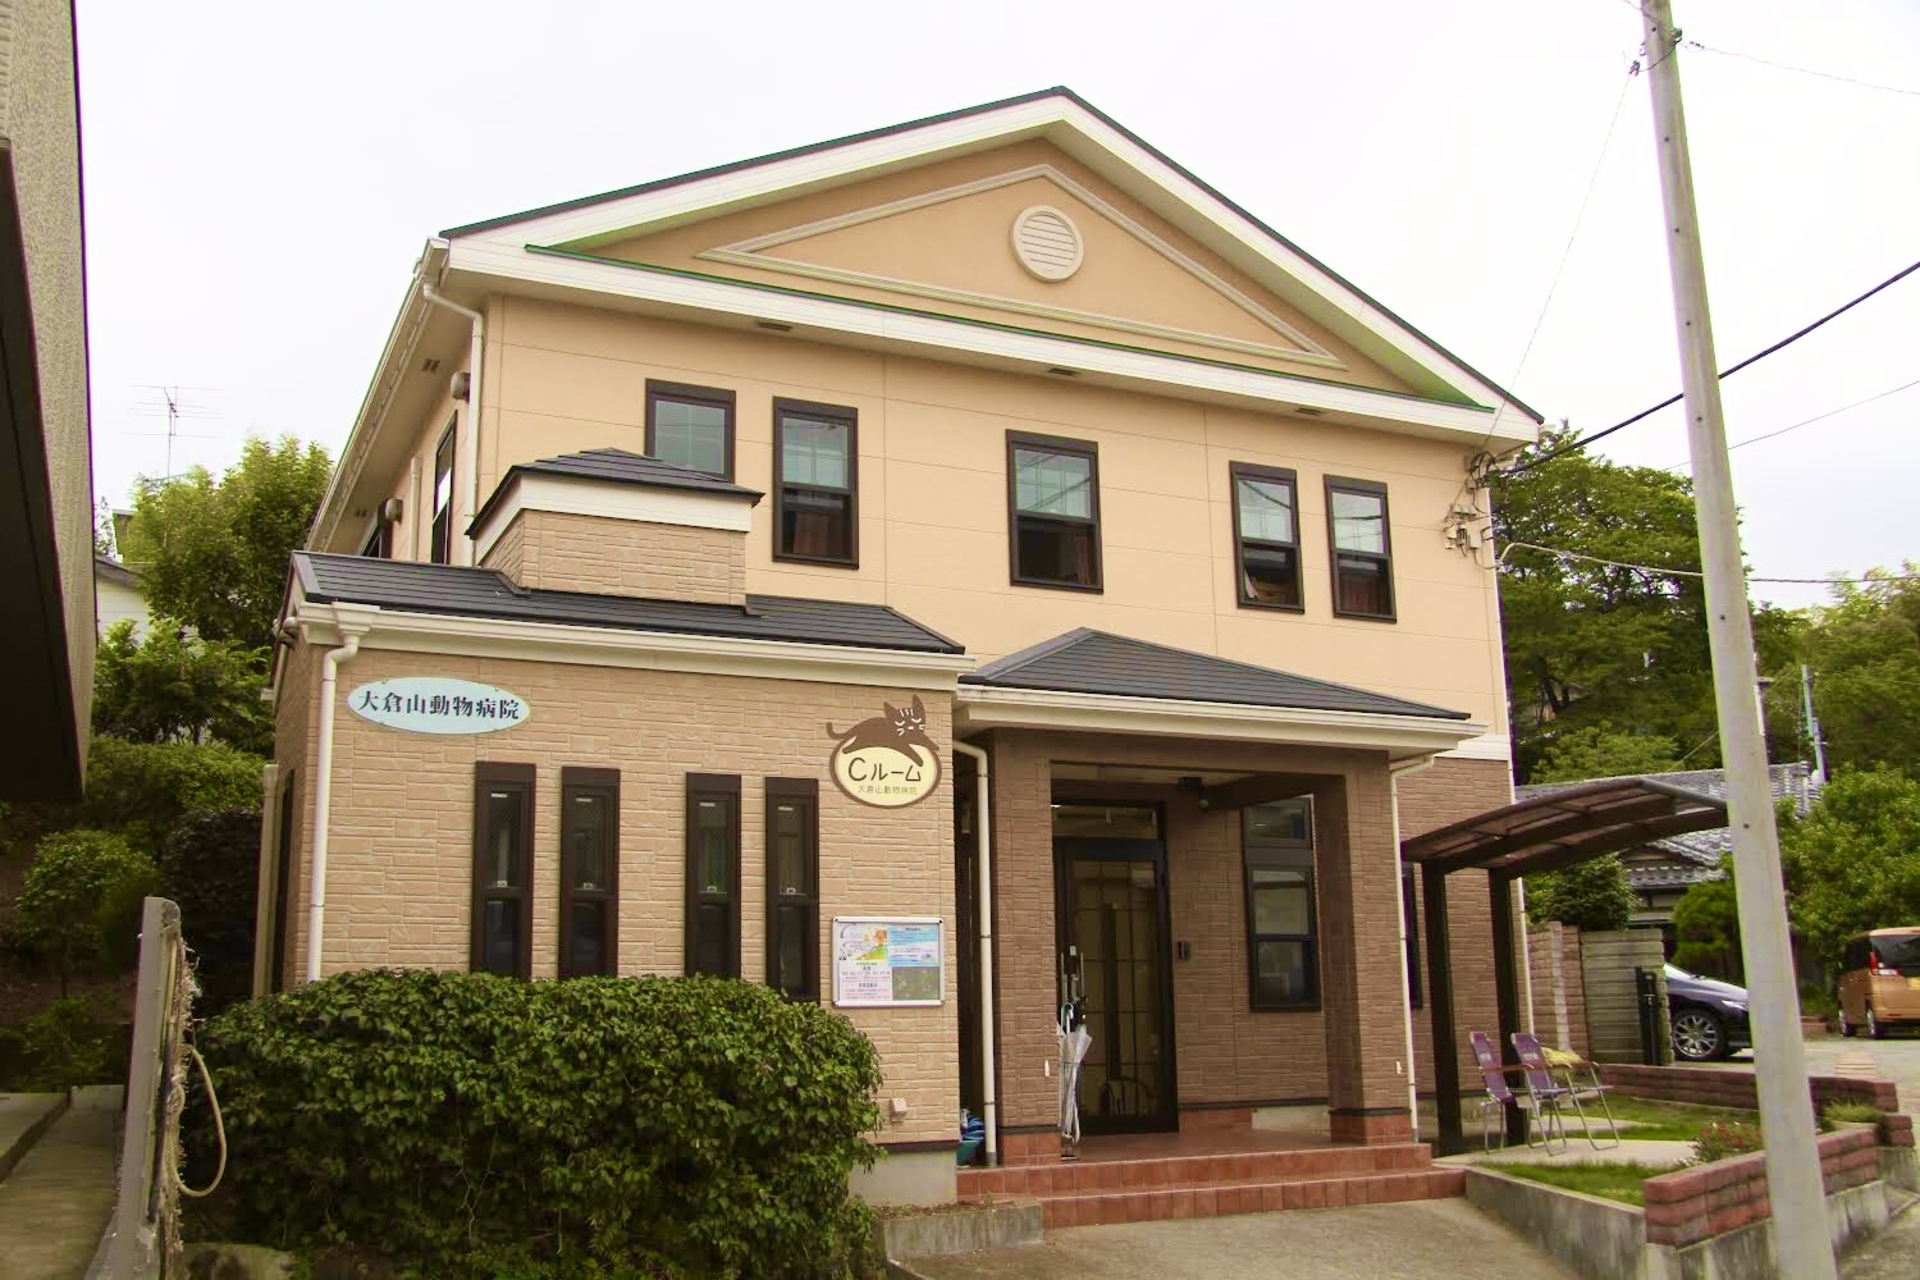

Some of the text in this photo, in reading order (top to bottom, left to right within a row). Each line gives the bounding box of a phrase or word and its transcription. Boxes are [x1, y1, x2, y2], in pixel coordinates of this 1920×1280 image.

[358, 690, 519, 720] 大倉山動物病院
[848, 757, 921, 781] Cルーム
